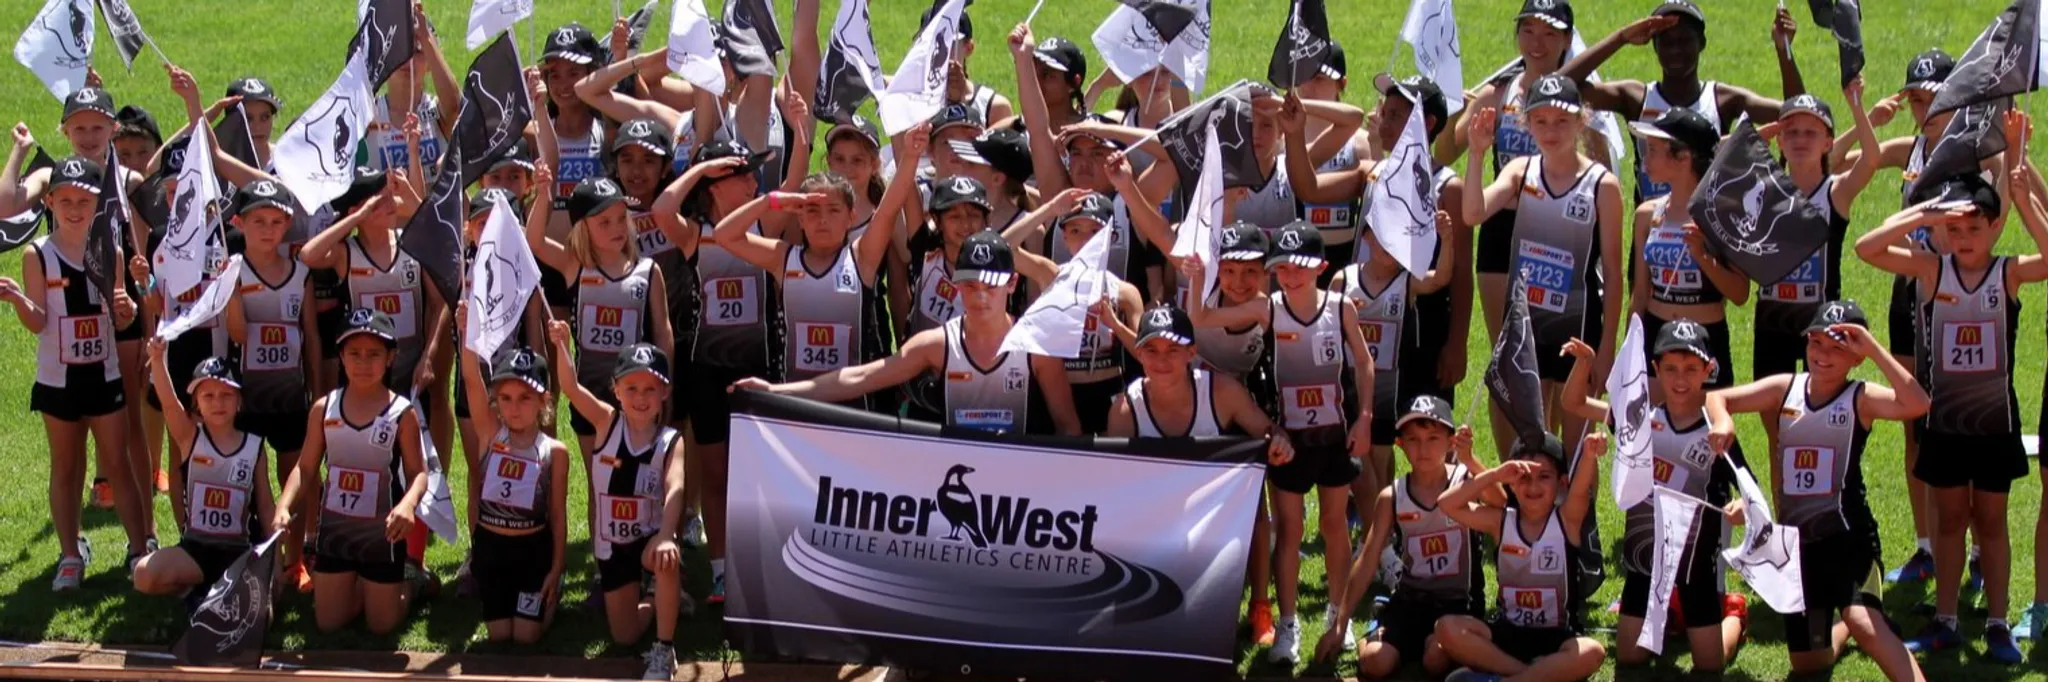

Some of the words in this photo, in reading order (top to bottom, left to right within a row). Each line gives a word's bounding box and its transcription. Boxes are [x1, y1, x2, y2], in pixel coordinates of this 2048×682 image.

[1570, 206, 1586, 217] 12
[406, 271, 415, 283] 9
[843, 275, 851, 286] 8
[720, 301, 743, 318] 20
[929, 296, 955, 320] 111
[1989, 296, 1998, 308] 9
[590, 327, 625, 345] 259
[72, 340, 102, 357] 185
[256, 347, 289, 363] 308
[803, 348, 839, 364] 345
[1326, 348, 1335, 361] 9
[1952, 348, 1984, 365] 211
[1008, 380, 1022, 390] 14
[1306, 409, 1318, 425] 2
[1831, 414, 1846, 424] 10
[379, 432, 388, 443] 9
[237, 470, 246, 482] 9
[1795, 472, 1815, 488] 19
[501, 481, 511, 498] 3
[340, 492, 360, 510] 17
[200, 508, 232, 528] 109
[814, 476, 938, 536] Inner
[980, 494, 1098, 553] West
[608, 521, 641, 538] 186
[810, 528, 877, 554] LITTLE
[886, 539, 999, 567] ATHLETICS
[1010, 552, 1092, 576] CENTRE
[1545, 556, 1553, 567] 7
[525, 599, 534, 609] 7
[1514, 608, 1547, 626] 284
